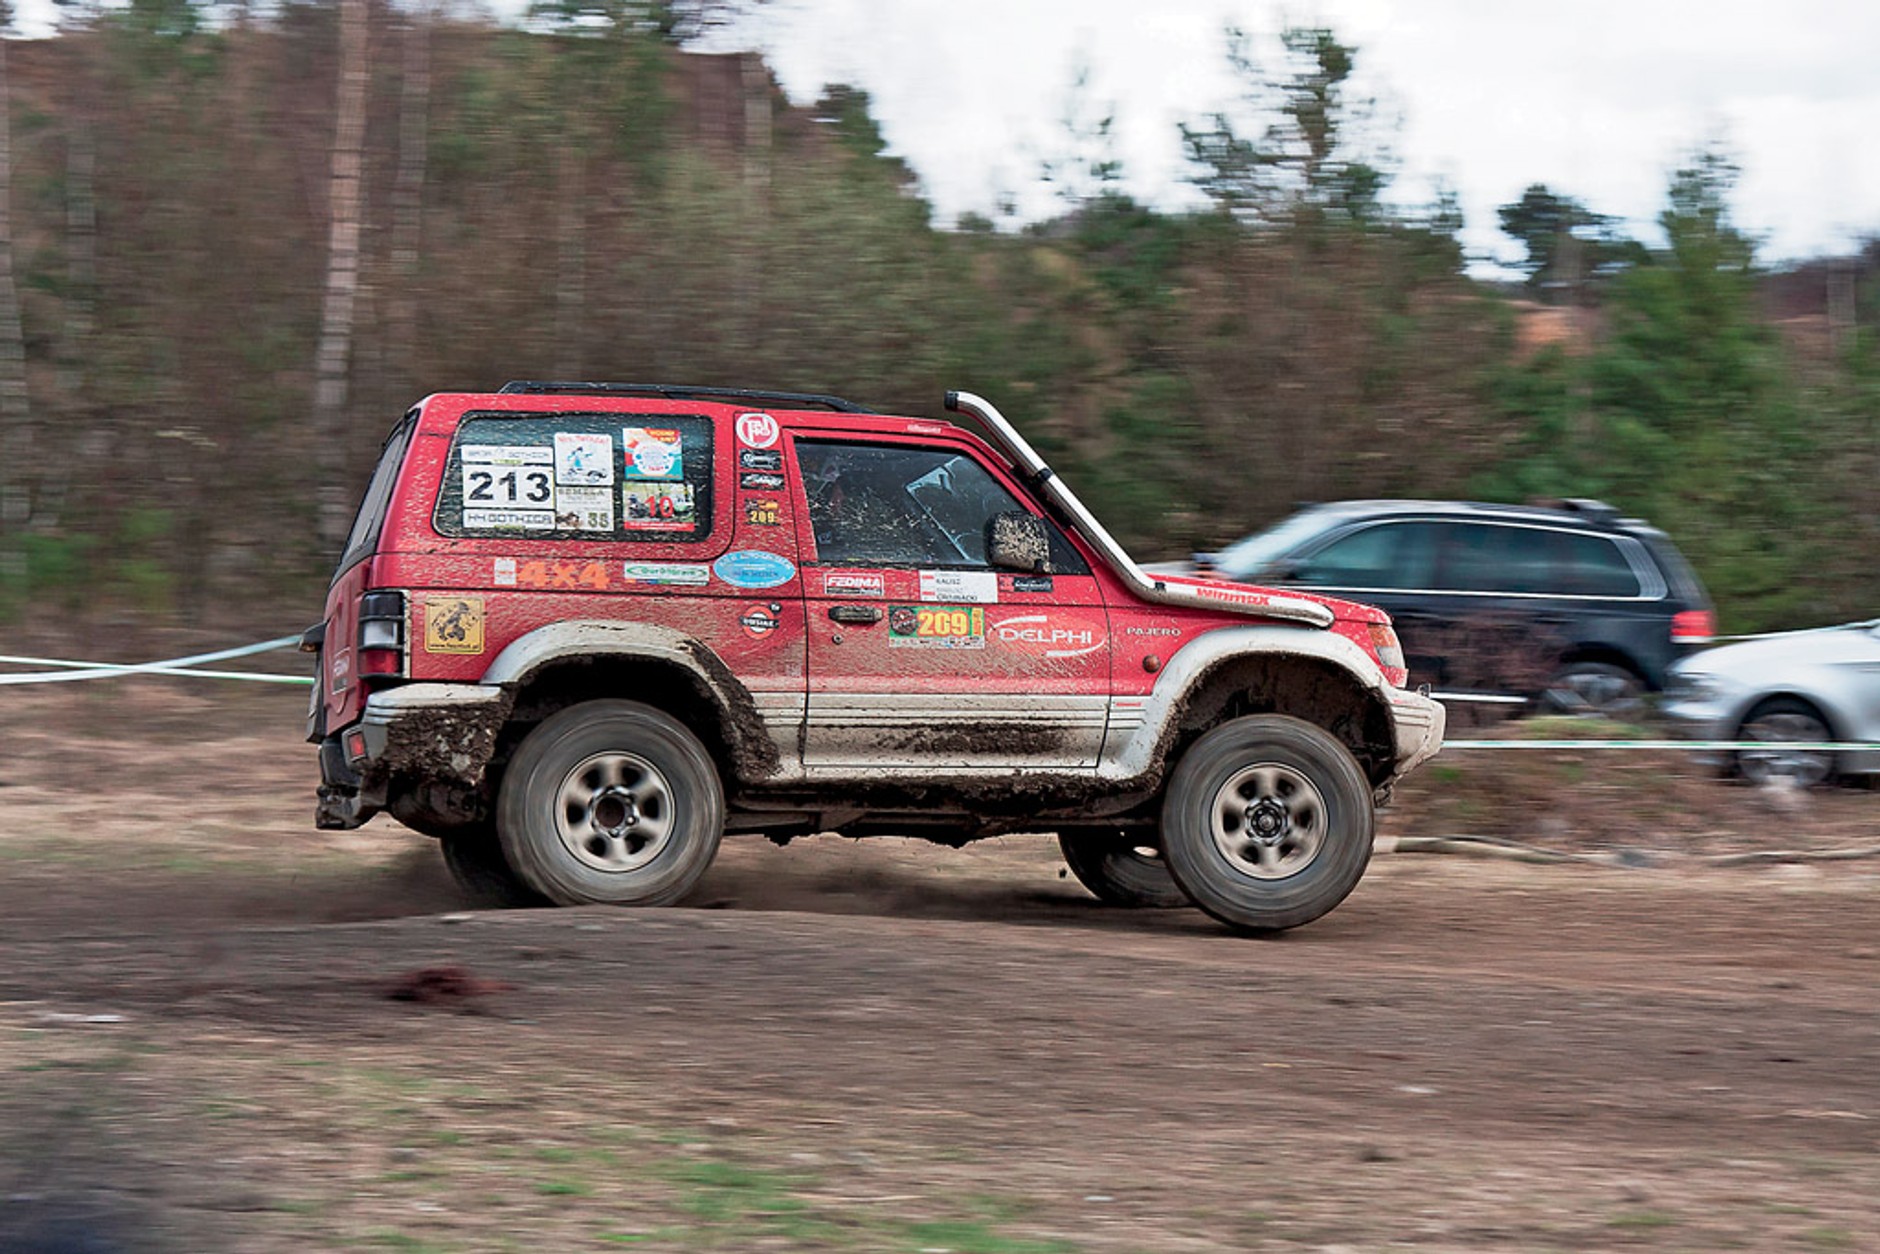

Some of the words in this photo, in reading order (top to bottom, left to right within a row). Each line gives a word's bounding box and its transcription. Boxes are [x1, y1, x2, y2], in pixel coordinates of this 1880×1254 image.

[468, 471, 551, 502] 213
[645, 496, 674, 518] 10
[750, 510, 775, 523] 209
[828, 576, 881, 587] FEDIMA
[1196, 588, 1270, 606] winmax
[917, 610, 969, 636] 209
[1127, 627, 1182, 636] PAJERO
[999, 628, 1092, 644] DELPHI
